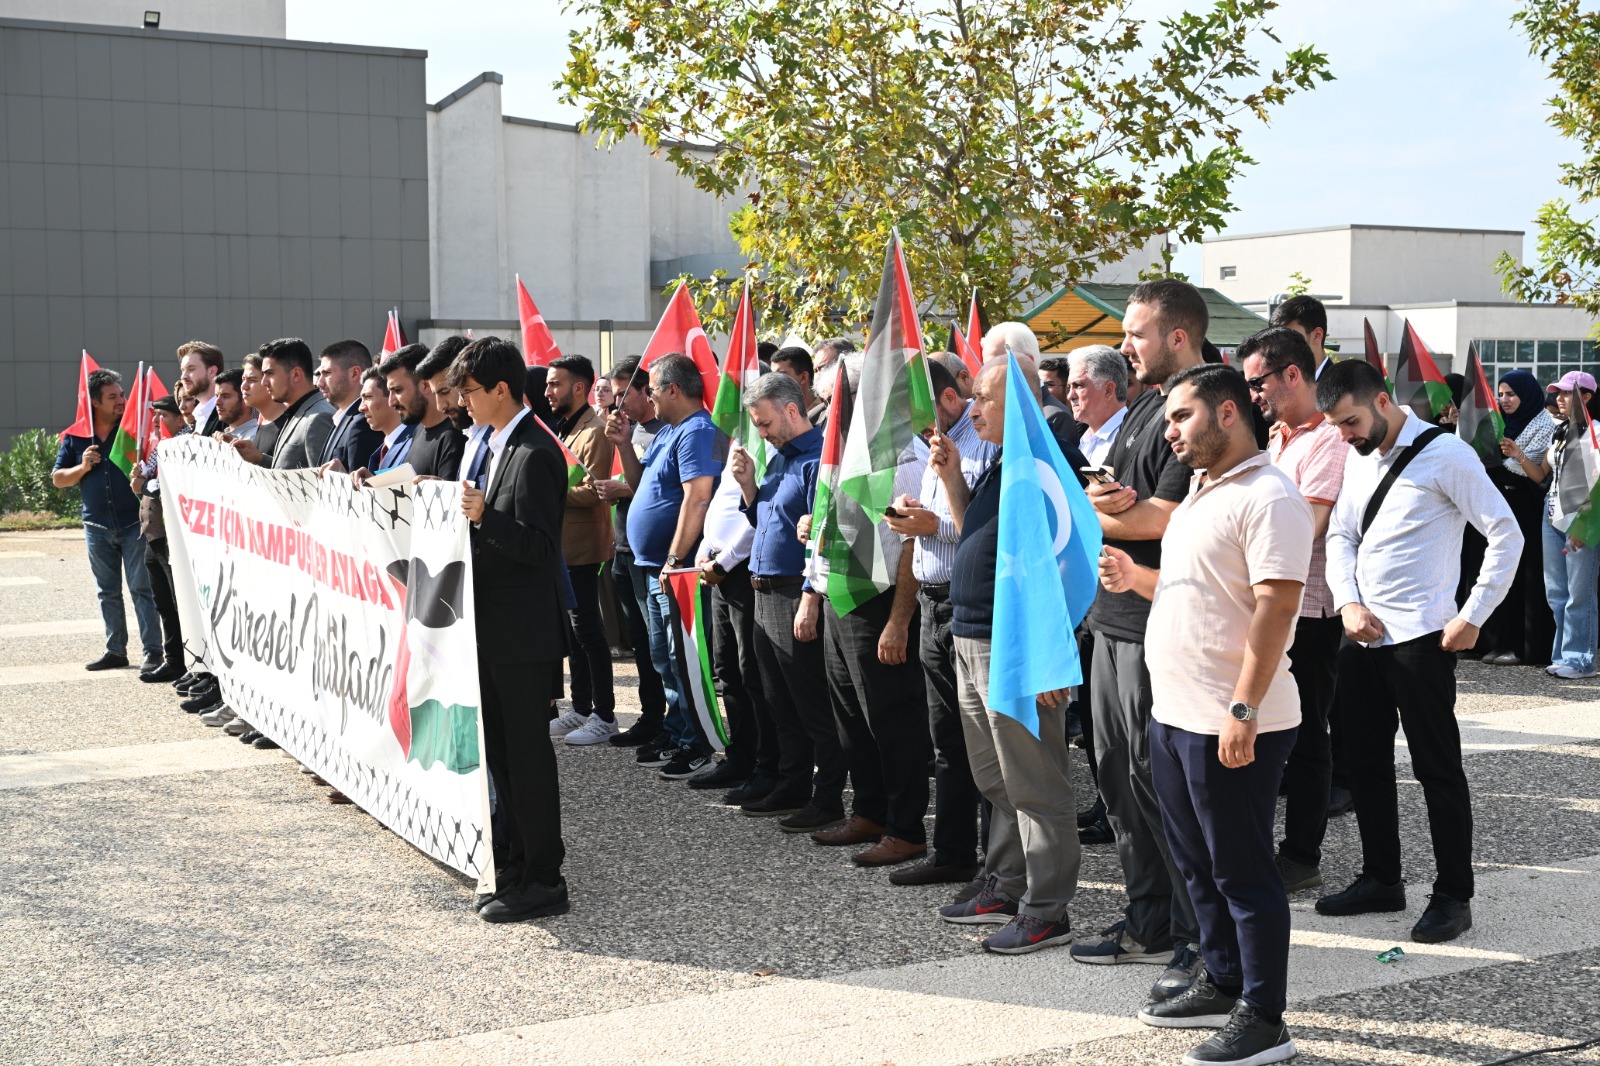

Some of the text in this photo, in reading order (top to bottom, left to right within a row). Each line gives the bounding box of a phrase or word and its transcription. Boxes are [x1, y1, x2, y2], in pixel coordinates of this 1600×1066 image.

[220, 494, 246, 555] İÇİN
[247, 516, 330, 587] KAMPÜSER
[210, 560, 299, 674] Küresel
